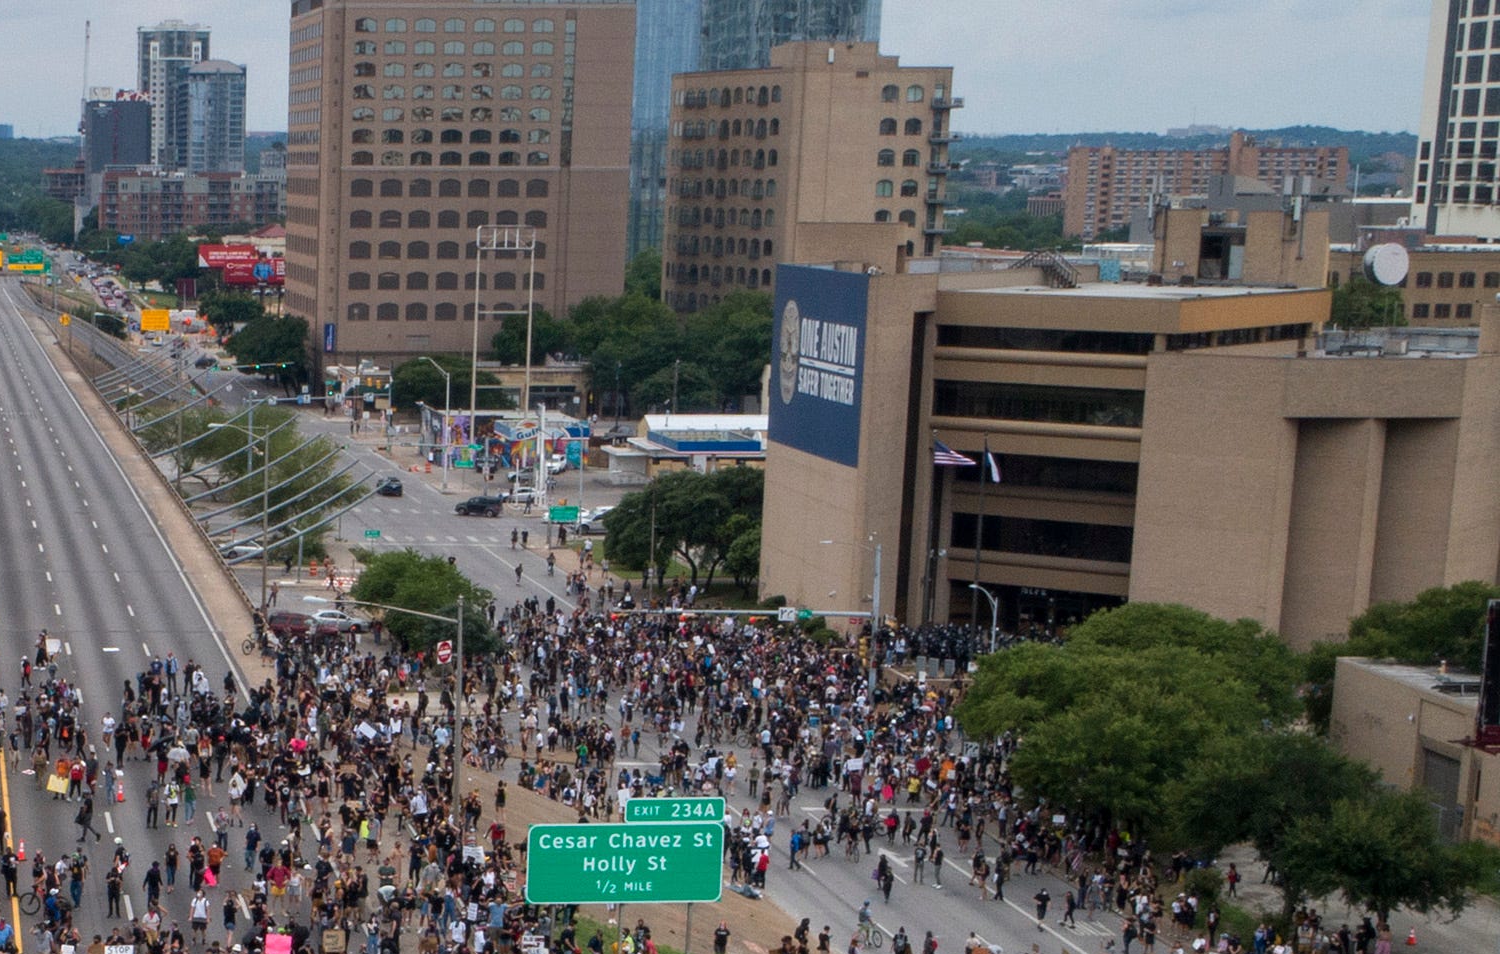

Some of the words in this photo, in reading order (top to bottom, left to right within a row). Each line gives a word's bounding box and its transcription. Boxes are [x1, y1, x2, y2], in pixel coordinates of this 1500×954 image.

[800, 318, 820, 358] ONE
[820, 322, 857, 367] AUSTIN
[798, 367, 819, 397] SAFER
[820, 372, 855, 406] TOGETHER
[634, 806, 660, 816] EXIT
[671, 803, 715, 818] 234A
[539, 834, 597, 849] Cesar
[608, 833, 681, 848] Chavez
[693, 832, 713, 847] St
[583, 856, 636, 875] Holly
[647, 855, 667, 871] St
[624, 881, 653, 891] MILE
[107, 946, 130, 954] STOP
